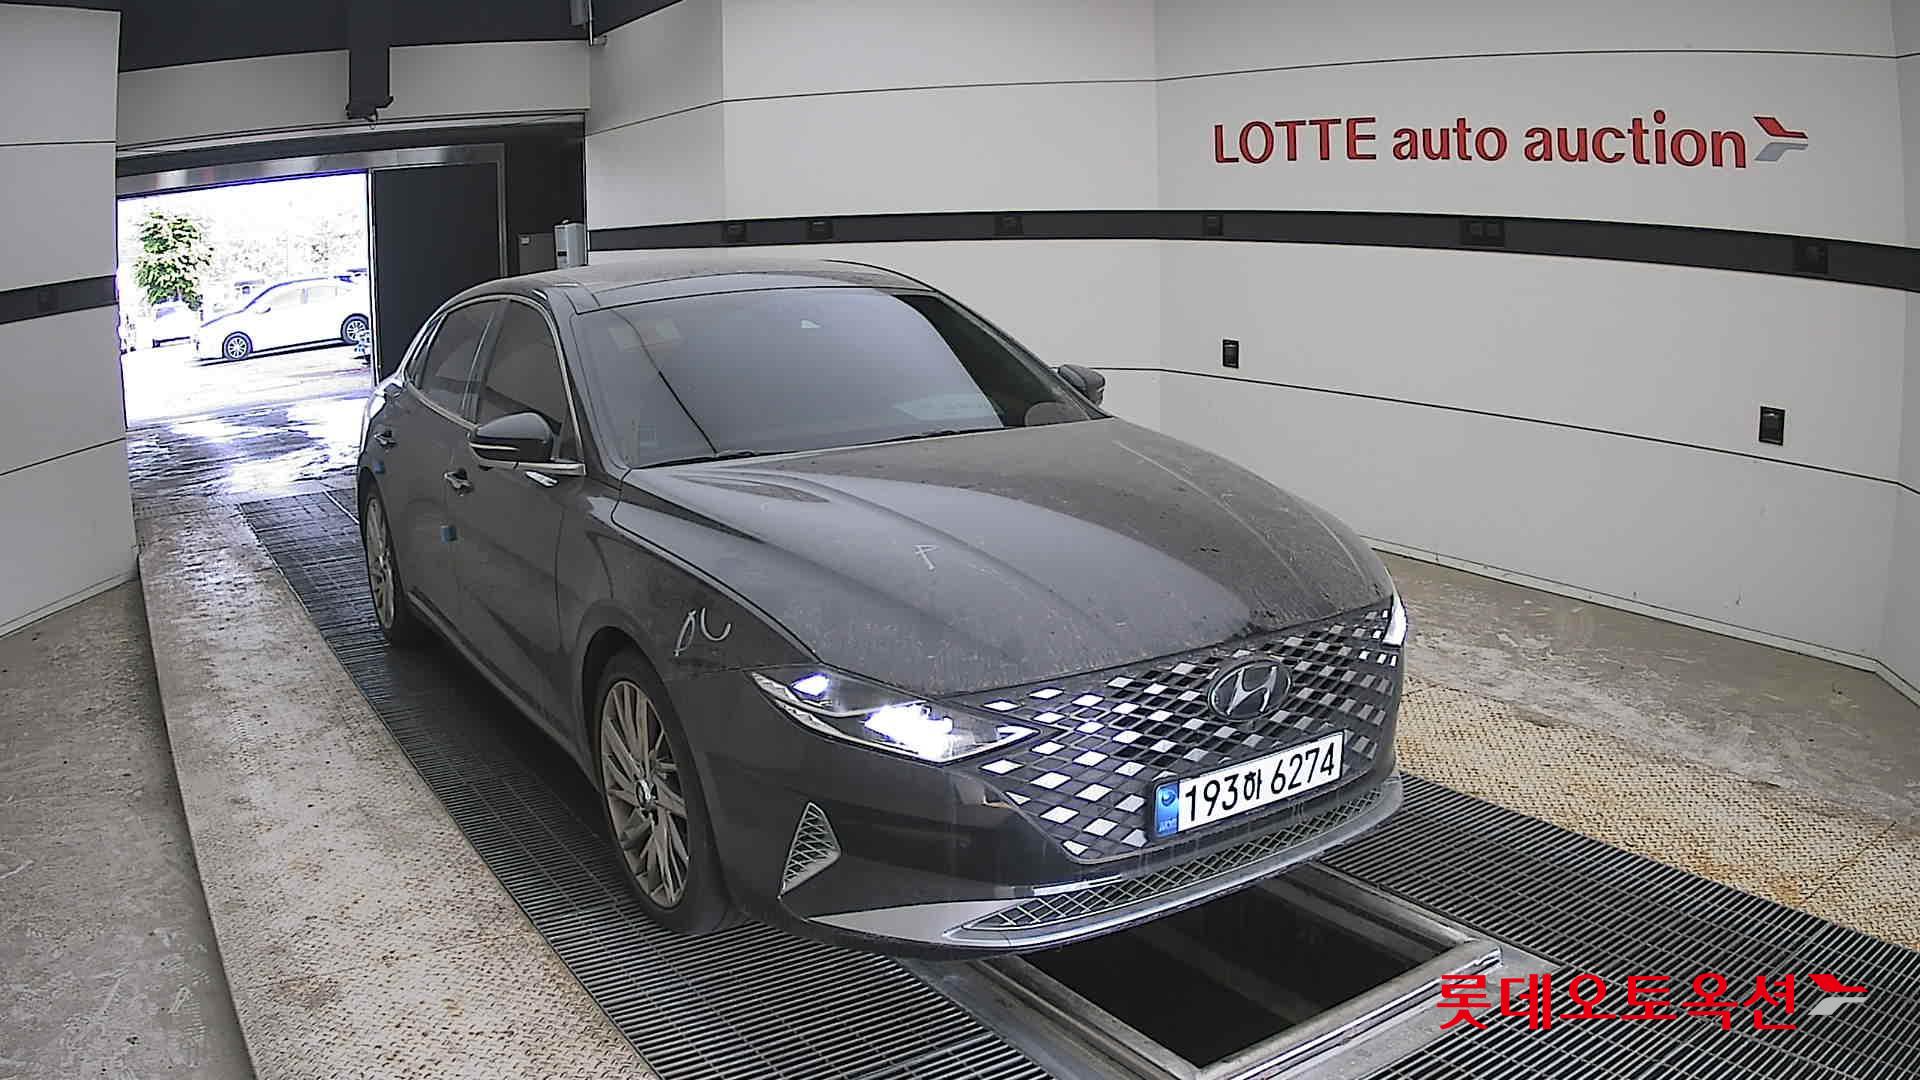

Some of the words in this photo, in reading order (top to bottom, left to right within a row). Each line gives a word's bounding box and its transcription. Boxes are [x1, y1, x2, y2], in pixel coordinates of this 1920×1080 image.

[1214, 116, 1377, 164] LOTTE
[1392, 117, 1508, 162] auto
[1523, 109, 1747, 169] auction
[1184, 767, 1263, 822] 193하
[1270, 742, 1335, 795] 6274
